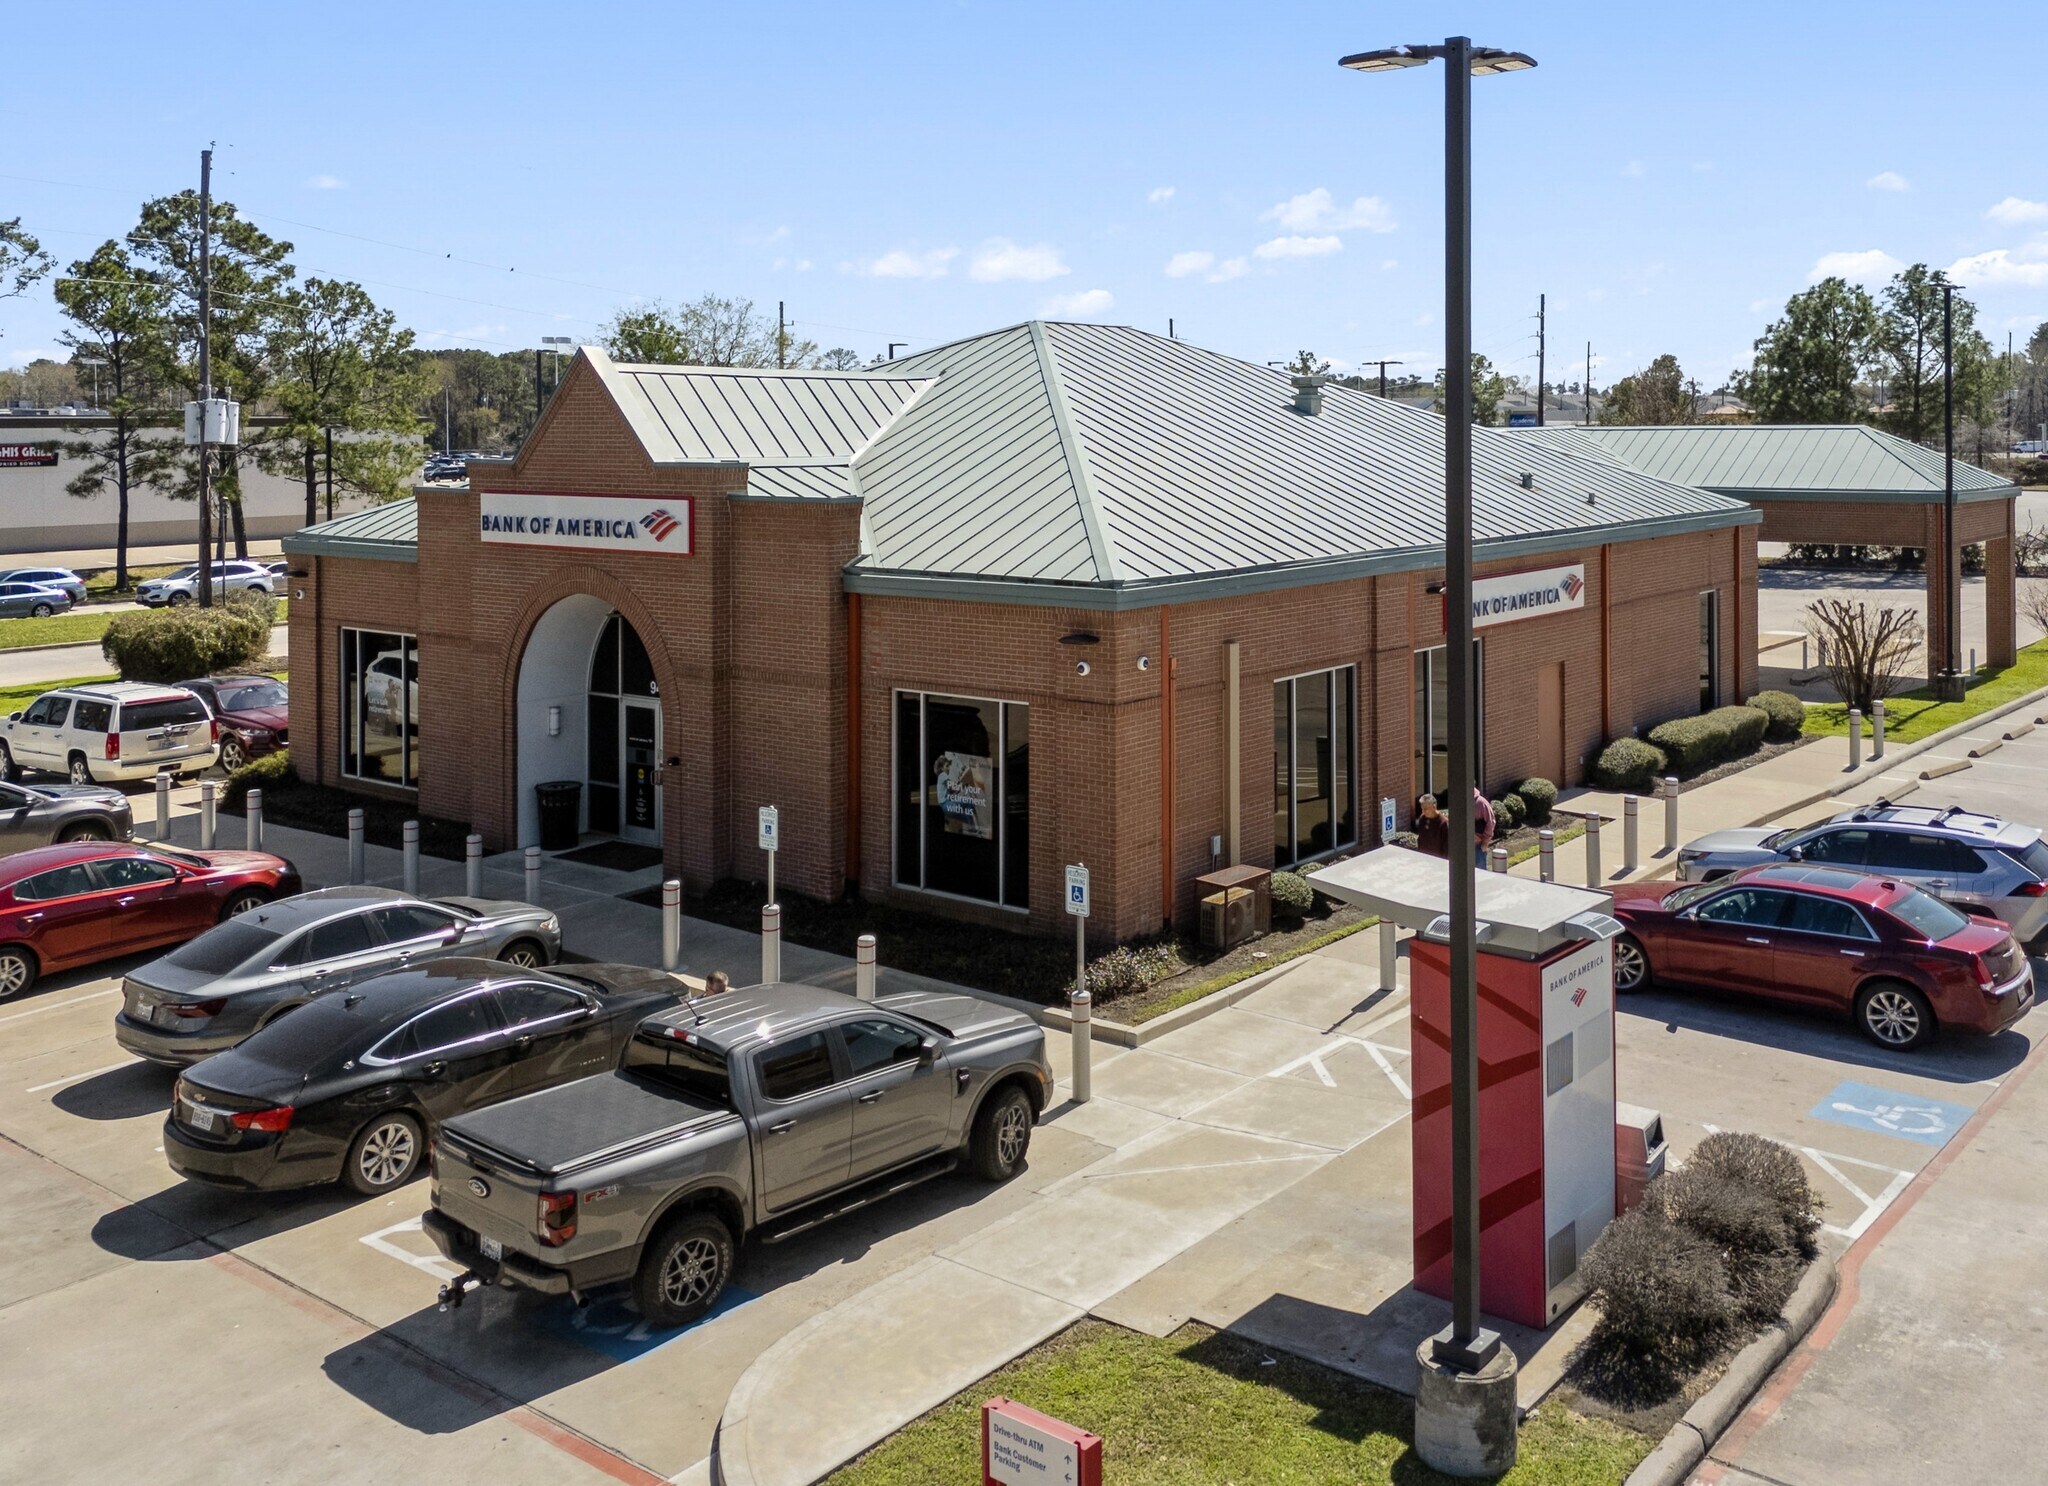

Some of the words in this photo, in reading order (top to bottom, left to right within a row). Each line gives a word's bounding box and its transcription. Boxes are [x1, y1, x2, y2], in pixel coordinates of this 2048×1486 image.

[0, 446, 19, 457] HIS
[482, 514, 526, 534] BANK
[530, 517, 551, 534] OF
[555, 518, 636, 539] AMERICA
[1473, 601, 1489, 618] NK
[1493, 597, 1508, 614] OF
[1510, 588, 1560, 612] AMERICA
[946, 780, 963, 791] Plan
[964, 783, 981, 794] your
[946, 803, 964, 814] with
[965, 807, 974, 816] us
[947, 793, 986, 807] retirement
[1550, 975, 1567, 992] BANK
[1568, 969, 1577, 981] OF
[1577, 955, 1604, 977] AMERICA
[993, 1423, 1028, 1446] Drive-thru
[1028, 1439, 1044, 1453] ATM
[994, 1441, 1012, 1456] Bank
[1012, 1449, 1046, 1472] Customer
[994, 1451, 1021, 1473] Parking
